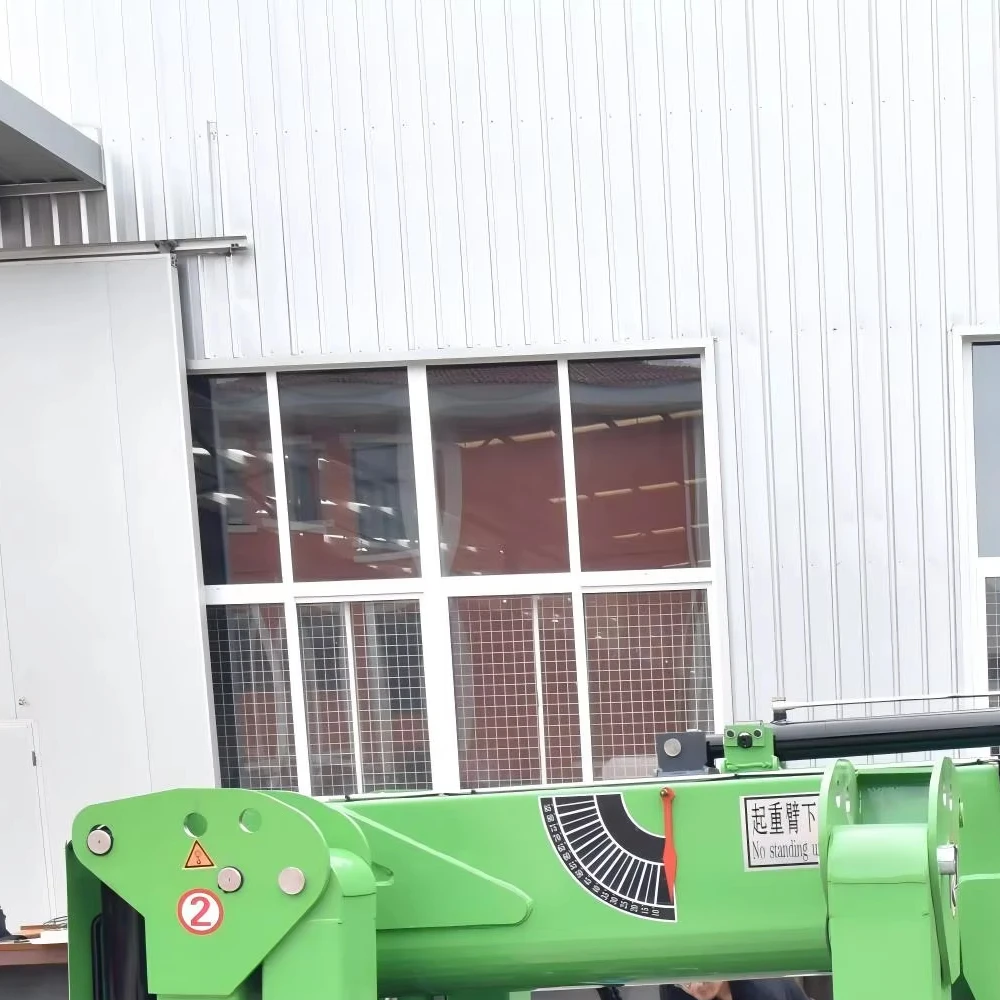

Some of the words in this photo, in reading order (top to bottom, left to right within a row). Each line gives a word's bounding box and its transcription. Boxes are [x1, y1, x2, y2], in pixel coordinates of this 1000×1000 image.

[752, 841, 766, 860] No
[769, 840, 809, 861] standing
[190, 896, 212, 927] 2
